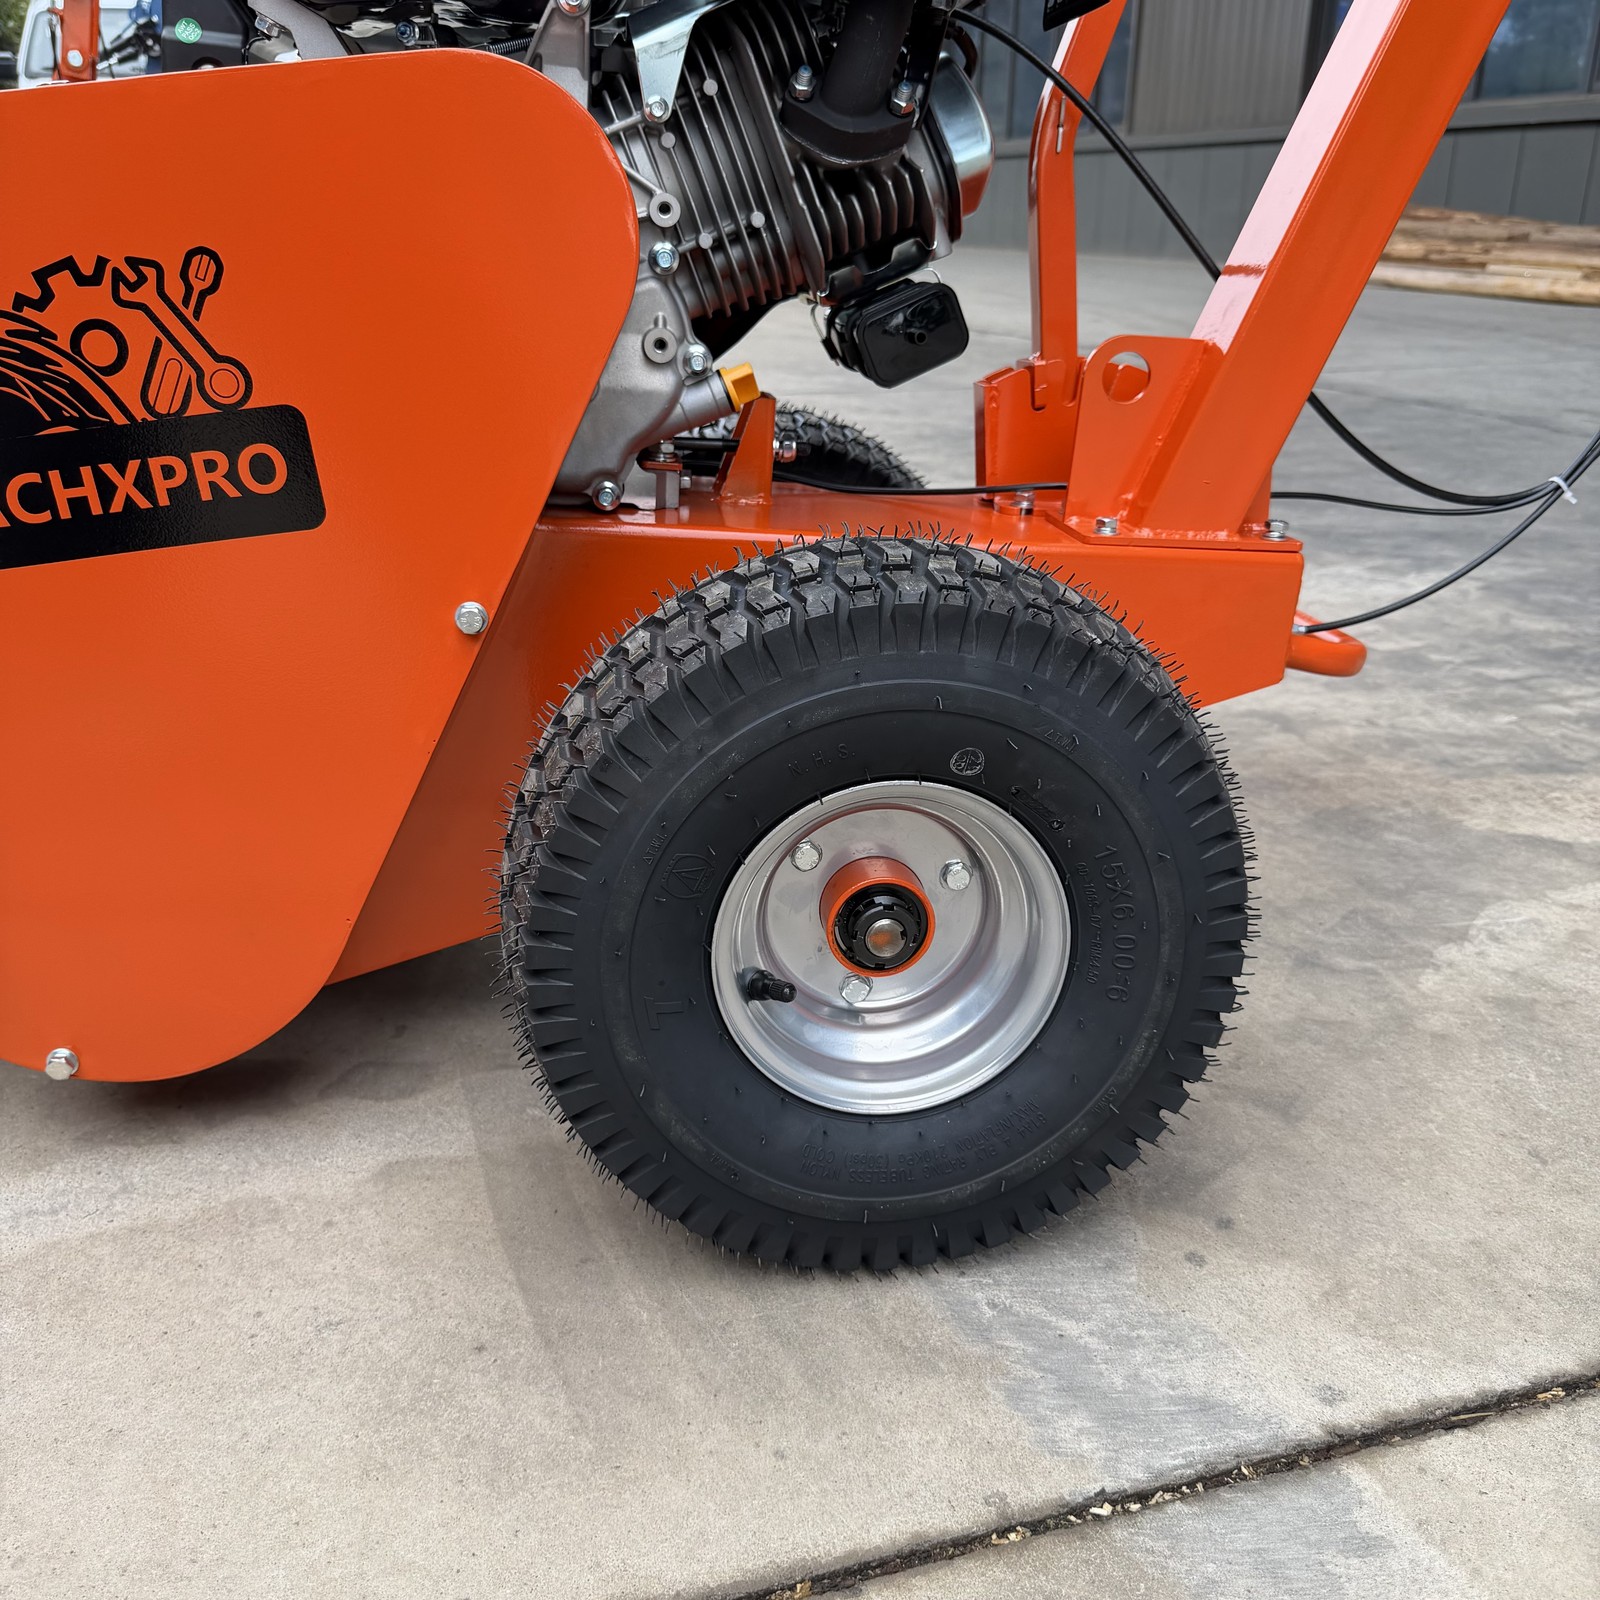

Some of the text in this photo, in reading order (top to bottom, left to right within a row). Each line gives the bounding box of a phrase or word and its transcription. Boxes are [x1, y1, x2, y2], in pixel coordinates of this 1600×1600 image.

[181, 22, 196, 38] PASS
[0, 443, 288, 528] CHXPRO
[801, 1142, 836, 1164] COLD
[974, 1144, 999, 1164] PLY
[799, 1158, 843, 1182] NYLON
[848, 1167, 916, 1184] TUBELESS
[922, 1157, 969, 1180] RATING
